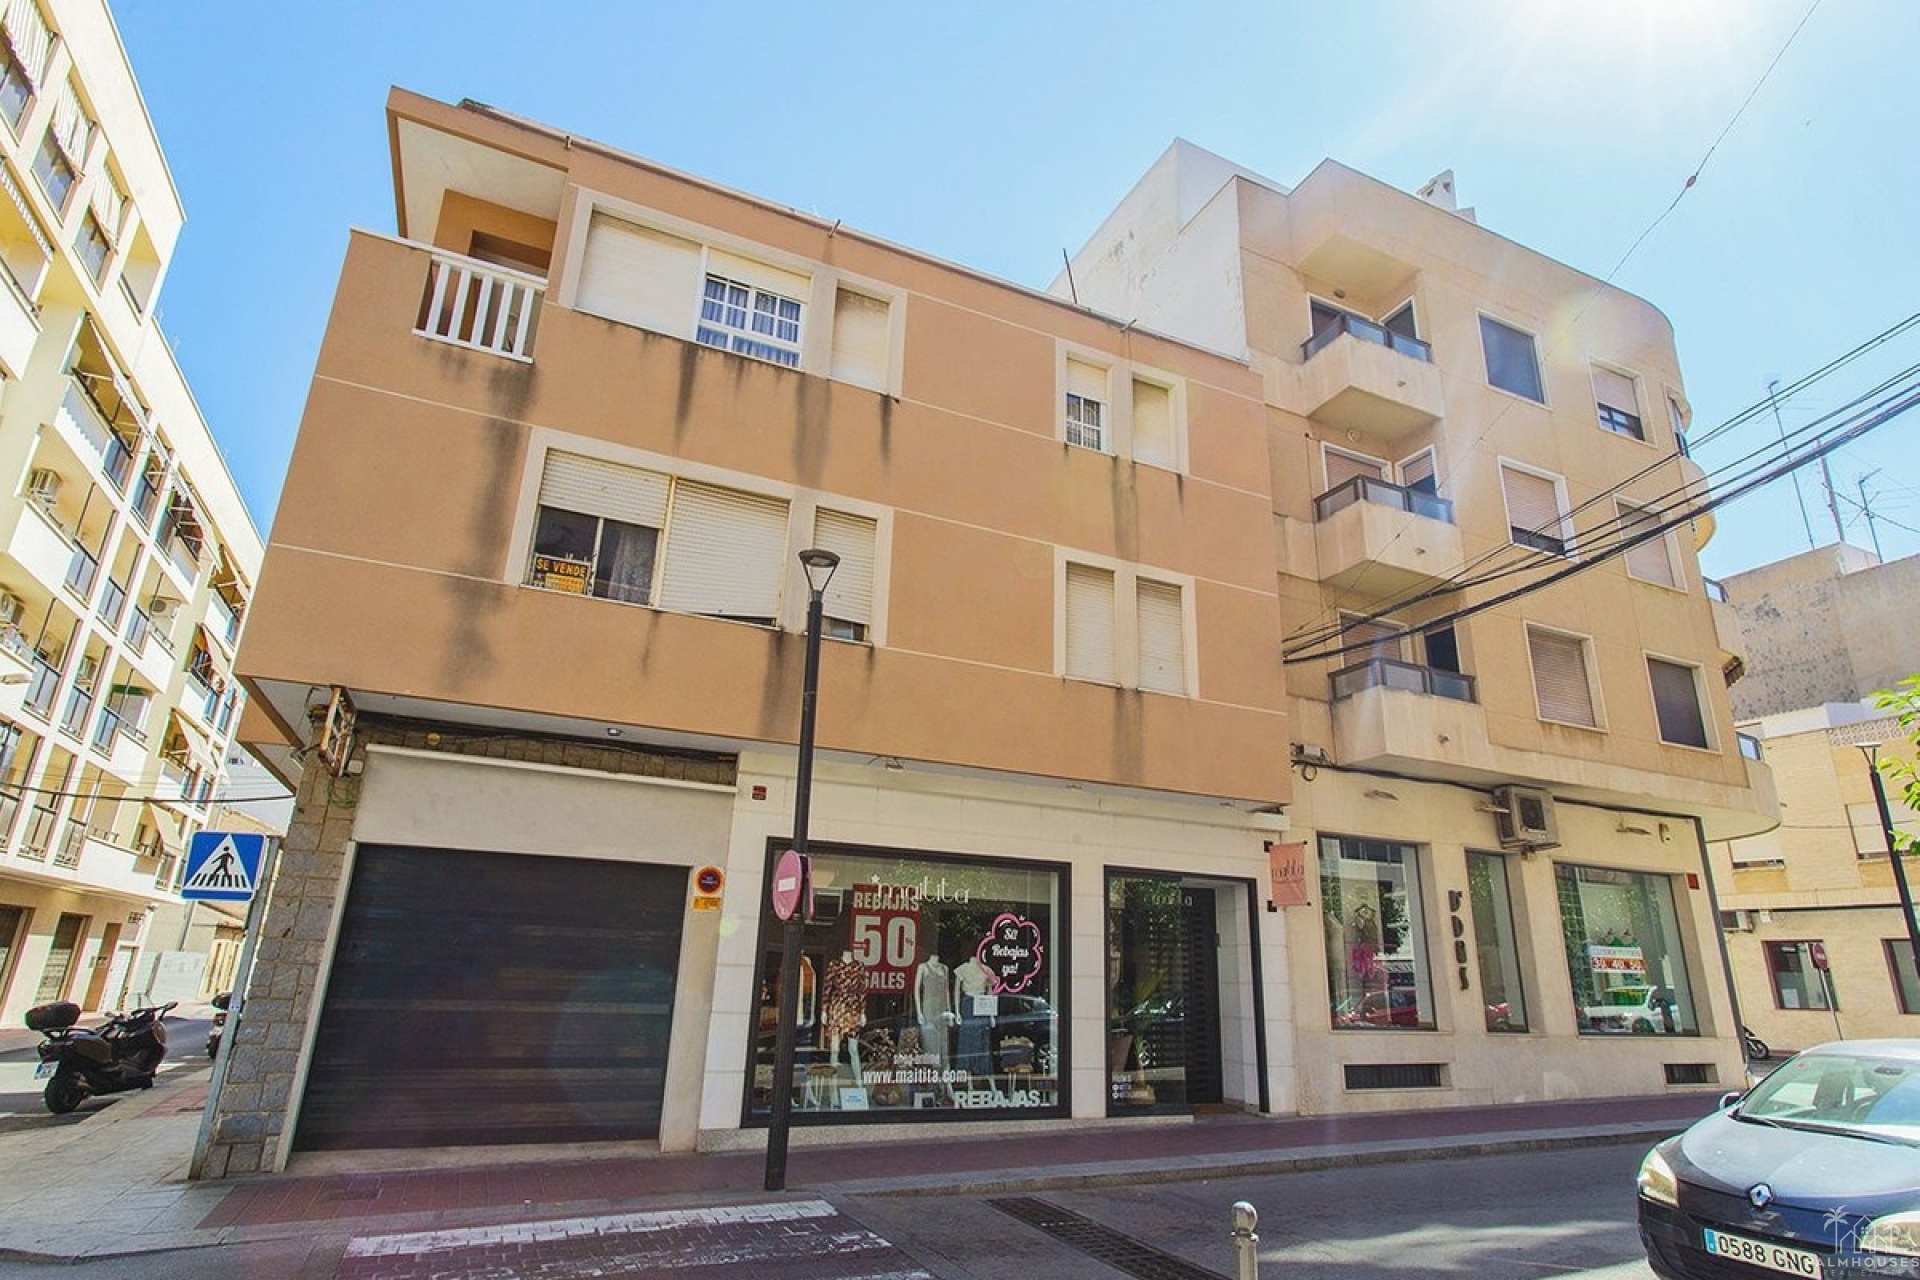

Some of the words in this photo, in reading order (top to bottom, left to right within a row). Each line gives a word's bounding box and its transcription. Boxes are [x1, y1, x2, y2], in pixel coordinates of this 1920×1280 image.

[537, 558, 550, 570] SE
[553, 561, 587, 578] VENDE
[853, 890, 919, 911] REBAJAS
[863, 1069, 967, 1084] www.maitita.com
[954, 1089, 1041, 1109] REBAJAS
[1718, 1236, 1766, 1263] 0588
[1773, 1249, 1814, 1274] GNG
